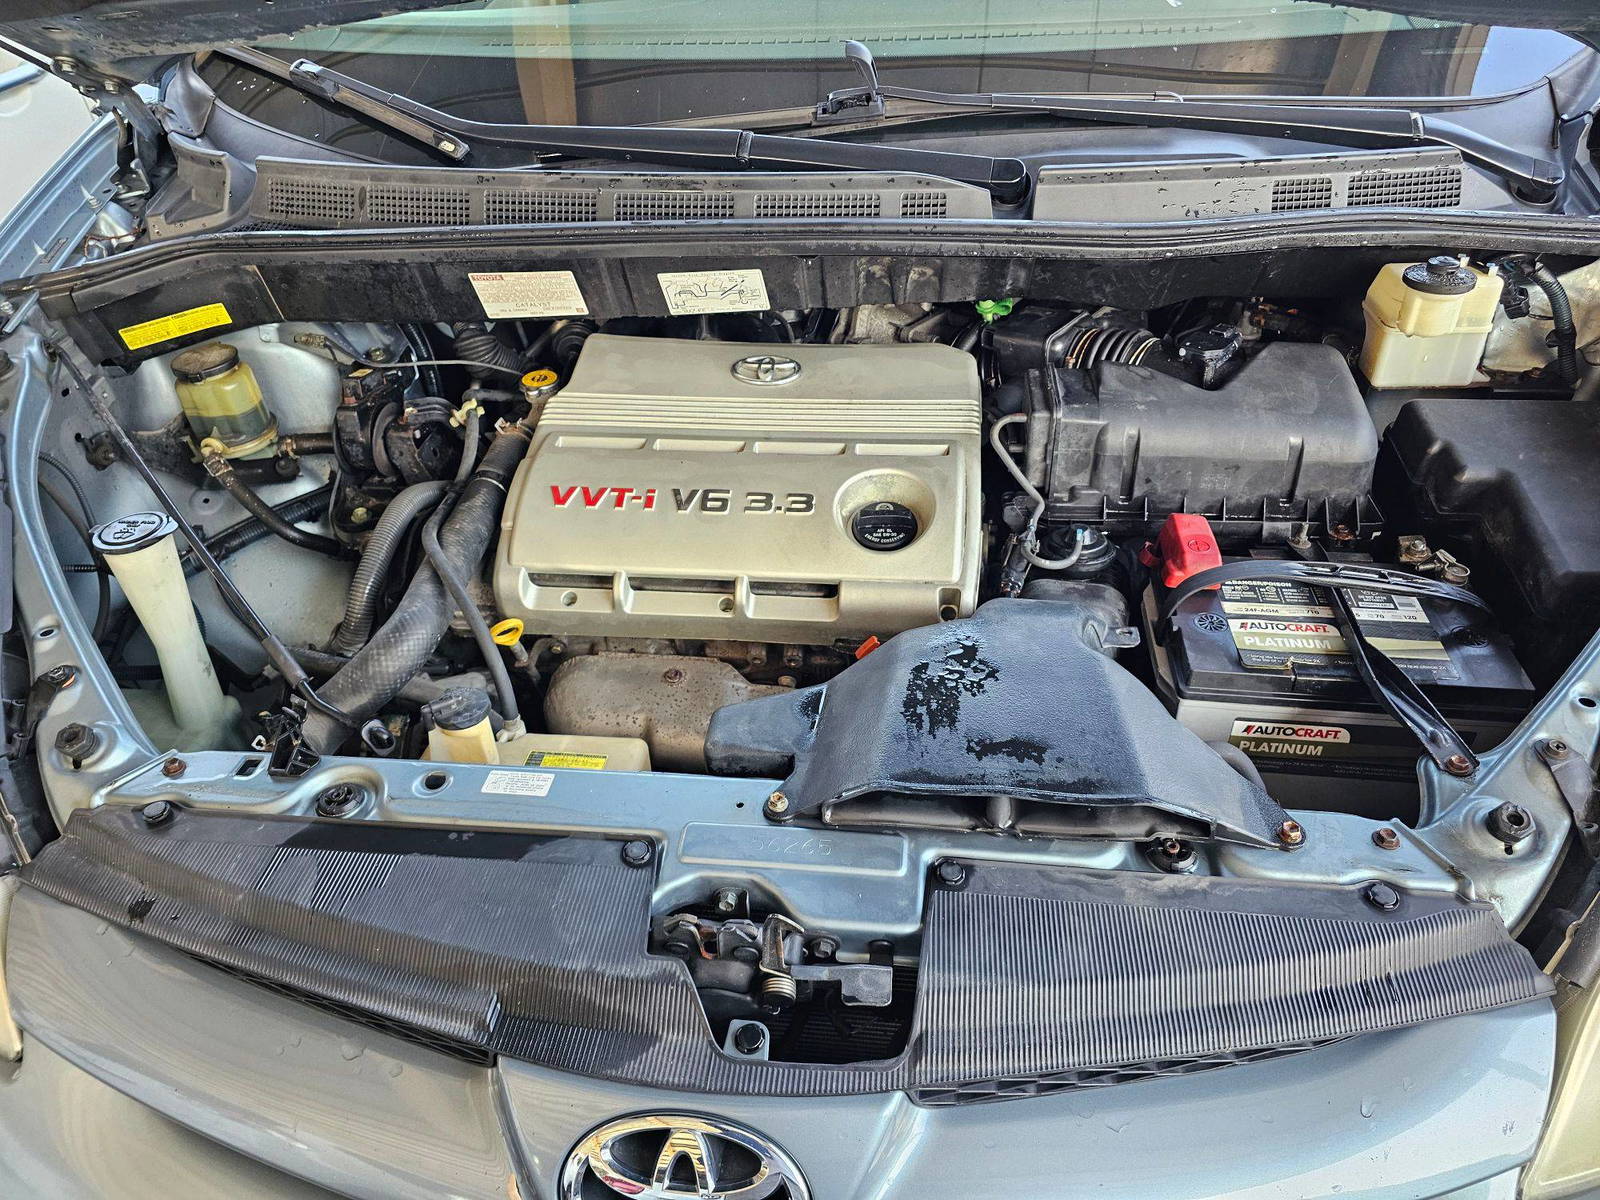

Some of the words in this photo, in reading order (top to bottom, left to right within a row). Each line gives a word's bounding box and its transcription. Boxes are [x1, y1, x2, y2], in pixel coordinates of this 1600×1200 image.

[549, 485, 657, 512] VVT-i
[672, 488, 731, 514] V6
[743, 491, 815, 516] 3.3
[1249, 621, 1330, 633] AUTOCRAFT
[1243, 636, 1333, 650] PLATINUM
[1253, 724, 1341, 740] AUTOCRAFT
[1239, 740, 1324, 756] PLATINUM
